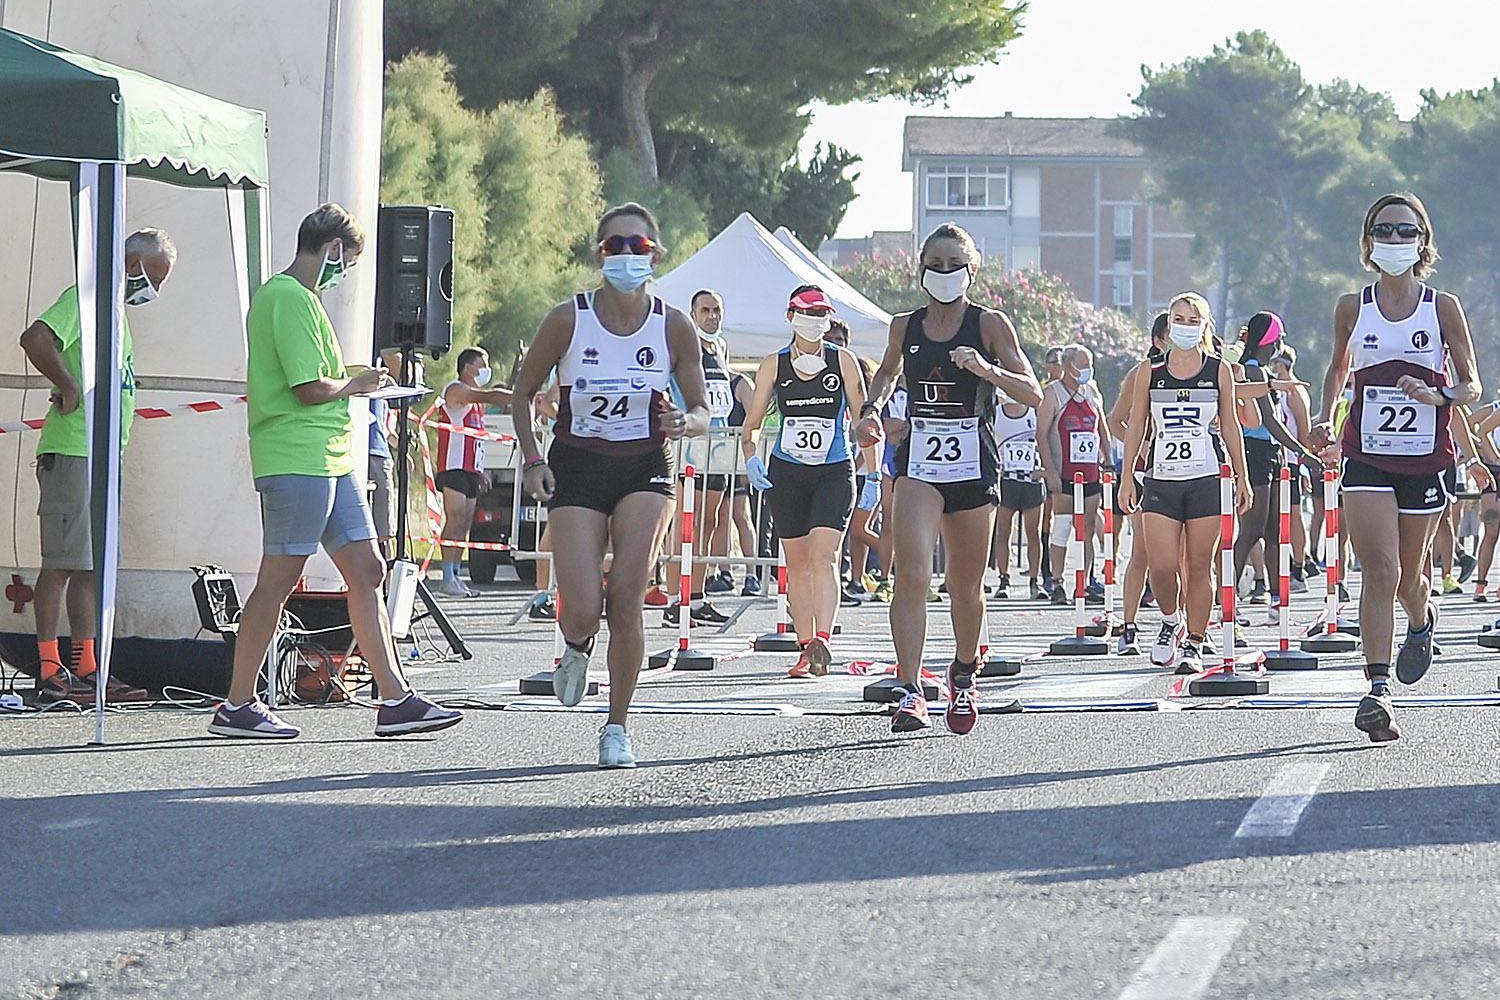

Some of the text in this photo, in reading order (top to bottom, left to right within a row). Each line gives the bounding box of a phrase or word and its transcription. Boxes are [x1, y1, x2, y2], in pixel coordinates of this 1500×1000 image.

[590, 396, 629, 420] 24
[1378, 406, 1417, 432] 22
[795, 431, 822, 449] 30
[926, 436, 961, 461] 23
[1079, 441, 1094, 452] 69
[1009, 450, 1031, 461] 196
[1165, 441, 1192, 460] 28
